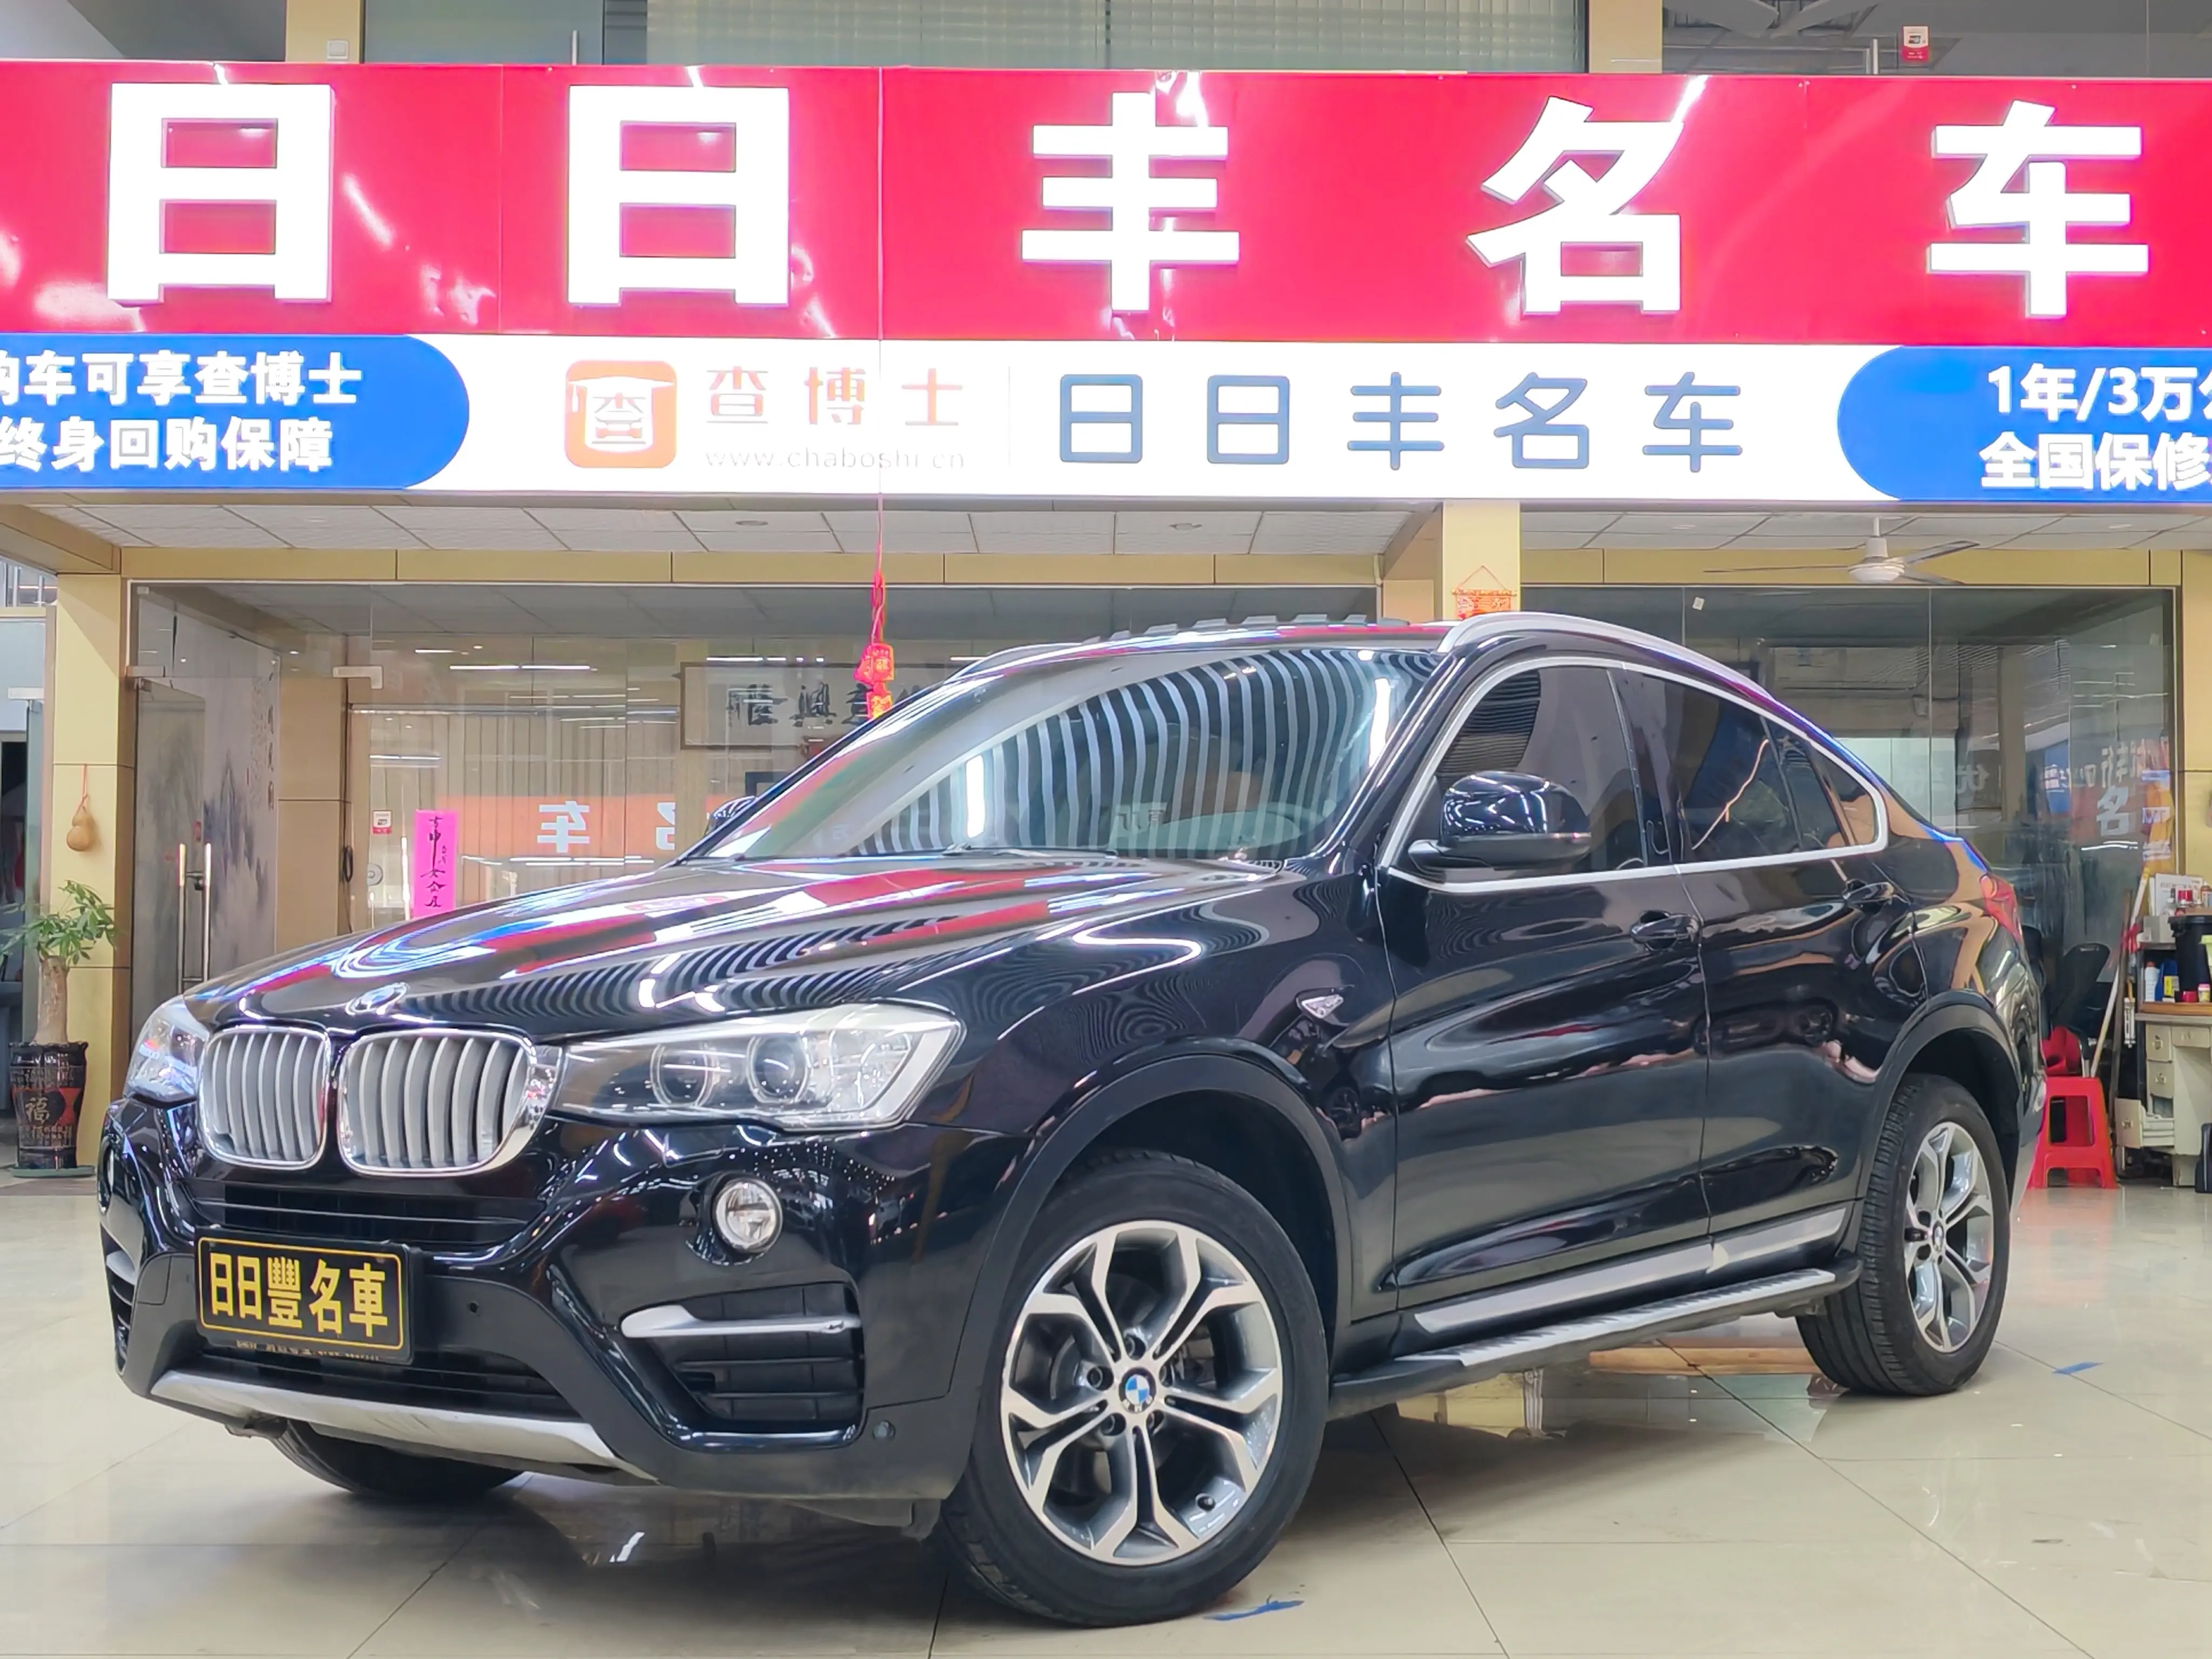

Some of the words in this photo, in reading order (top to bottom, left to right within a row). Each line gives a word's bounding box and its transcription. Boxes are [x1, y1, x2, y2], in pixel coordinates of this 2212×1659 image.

[107, 83, 2150, 318] 日日丰名车
[706, 367, 963, 426] 查博士
[1060, 372, 1743, 473] 日日丰名车
[1988, 363, 2212, 422] 1年/3万
[705, 446, 964, 469] www.chaboshicn
[209, 1252, 388, 1339] 日日豐名車
